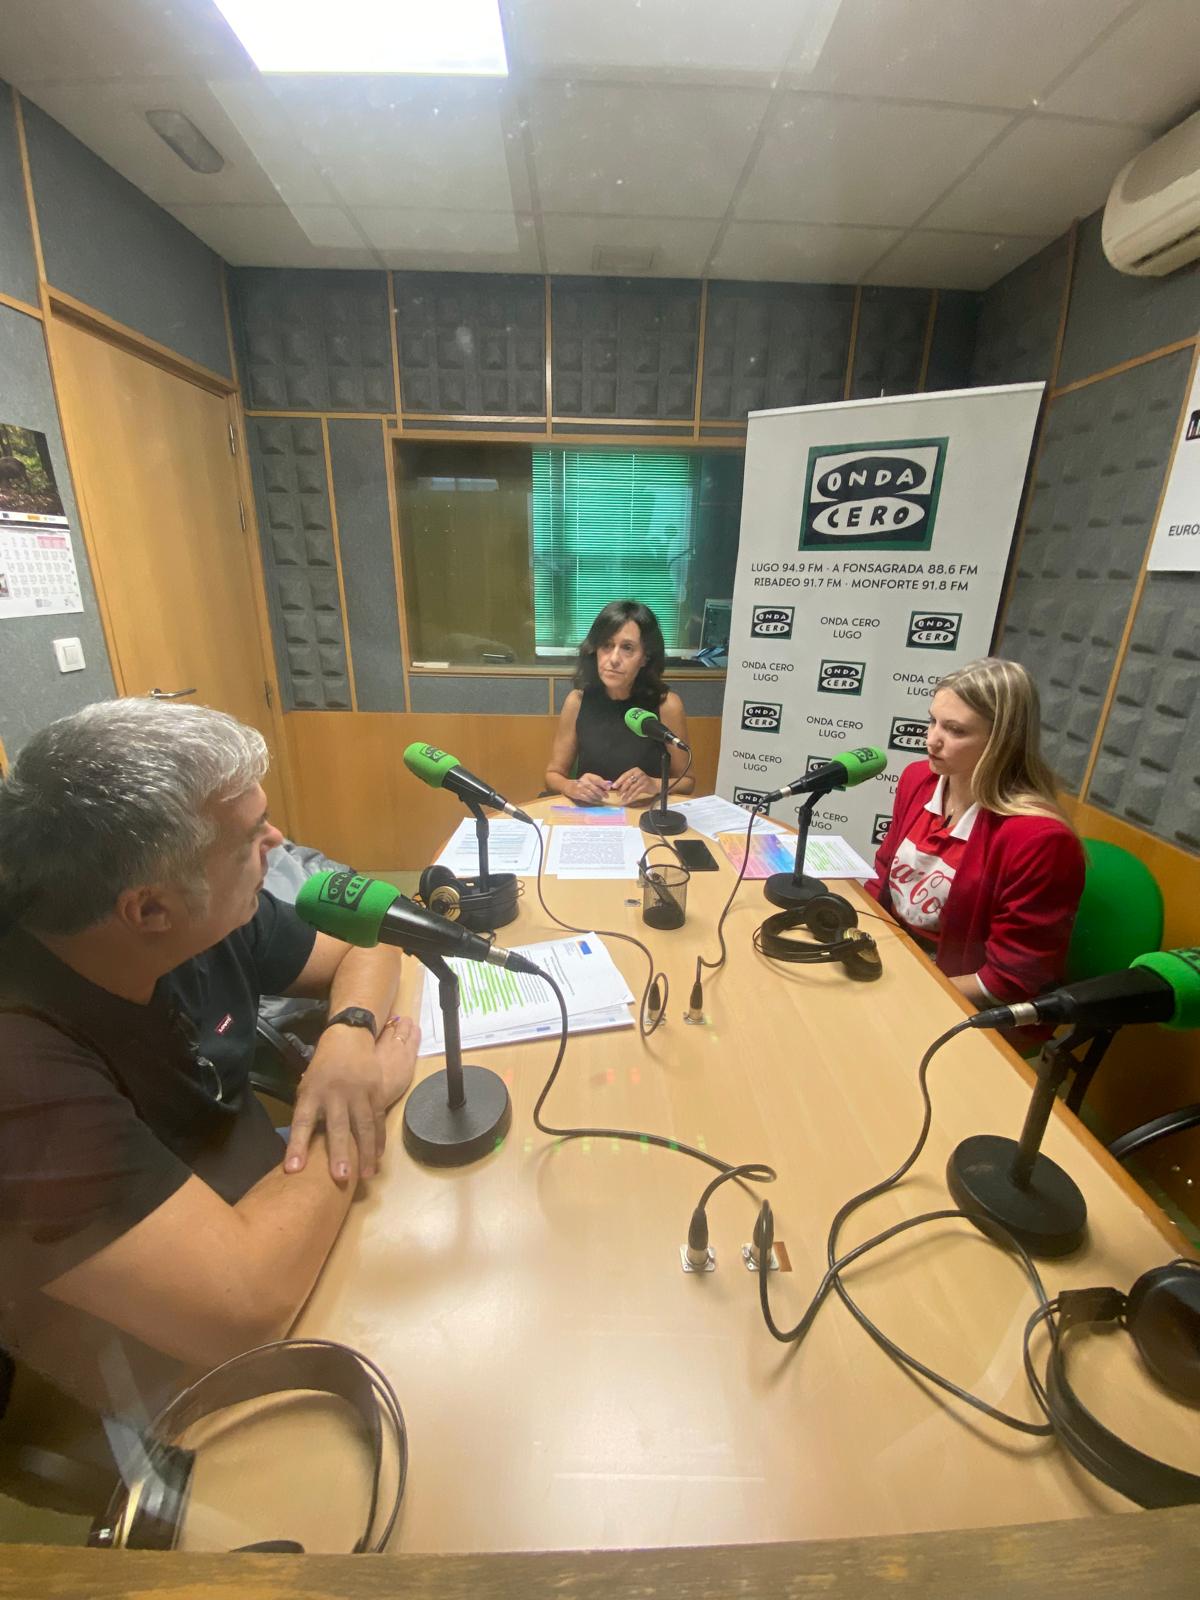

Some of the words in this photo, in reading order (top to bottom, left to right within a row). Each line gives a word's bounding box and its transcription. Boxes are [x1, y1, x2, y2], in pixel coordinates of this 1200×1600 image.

[827, 468, 914, 491] ONDA
[827, 505, 909, 528] CERO
[1168, 524, 1200, 536] EURO
[751, 563, 779, 573] LUGO
[782, 563, 804, 573] 94.9
[807, 563, 823, 573] FM
[832, 563, 840, 573] A
[843, 563, 924, 574] FONSAGRADA
[927, 564, 956, 575] 88.6
[959, 564, 978, 575] FM
[754, 577, 801, 588] RIBADEO
[803, 578, 824, 588] 91.7
[827, 578, 842, 588] FM
[851, 579, 919, 590] MONFORTE
[922, 580, 947, 590] 91.8
[950, 580, 969, 591] FM
[758, 613, 787, 621] ONDA
[820, 616, 849, 627] ONDA
[851, 617, 881, 628] CERO
[759, 624, 785, 632] CERO
[917, 619, 951, 629] ONDA
[833, 629, 862, 640] LUGO
[917, 632, 949, 642] CERO
[741, 660, 767, 670] ONDA
[769, 662, 795, 672] CERO
[826, 667, 857, 676] ONDA
[753, 673, 779, 683] LUGO
[826, 679, 855, 688] CERO
[892, 672, 925, 684] ONDA
[927, 675, 942, 685] CE
[748, 707, 776, 717] ONDA
[748, 718, 775, 727] CERO
[806, 715, 834, 727] ONDA
[836, 718, 864, 730] CERO
[818, 728, 846, 740] LUGO
[732, 750, 756, 761] ONDA
[758, 753, 782, 764] CERO
[743, 762, 768, 773] LUGO
[875, 773, 900, 783] OND
[822, 811, 849, 823] CERO
[809, 820, 833, 831] UGO
